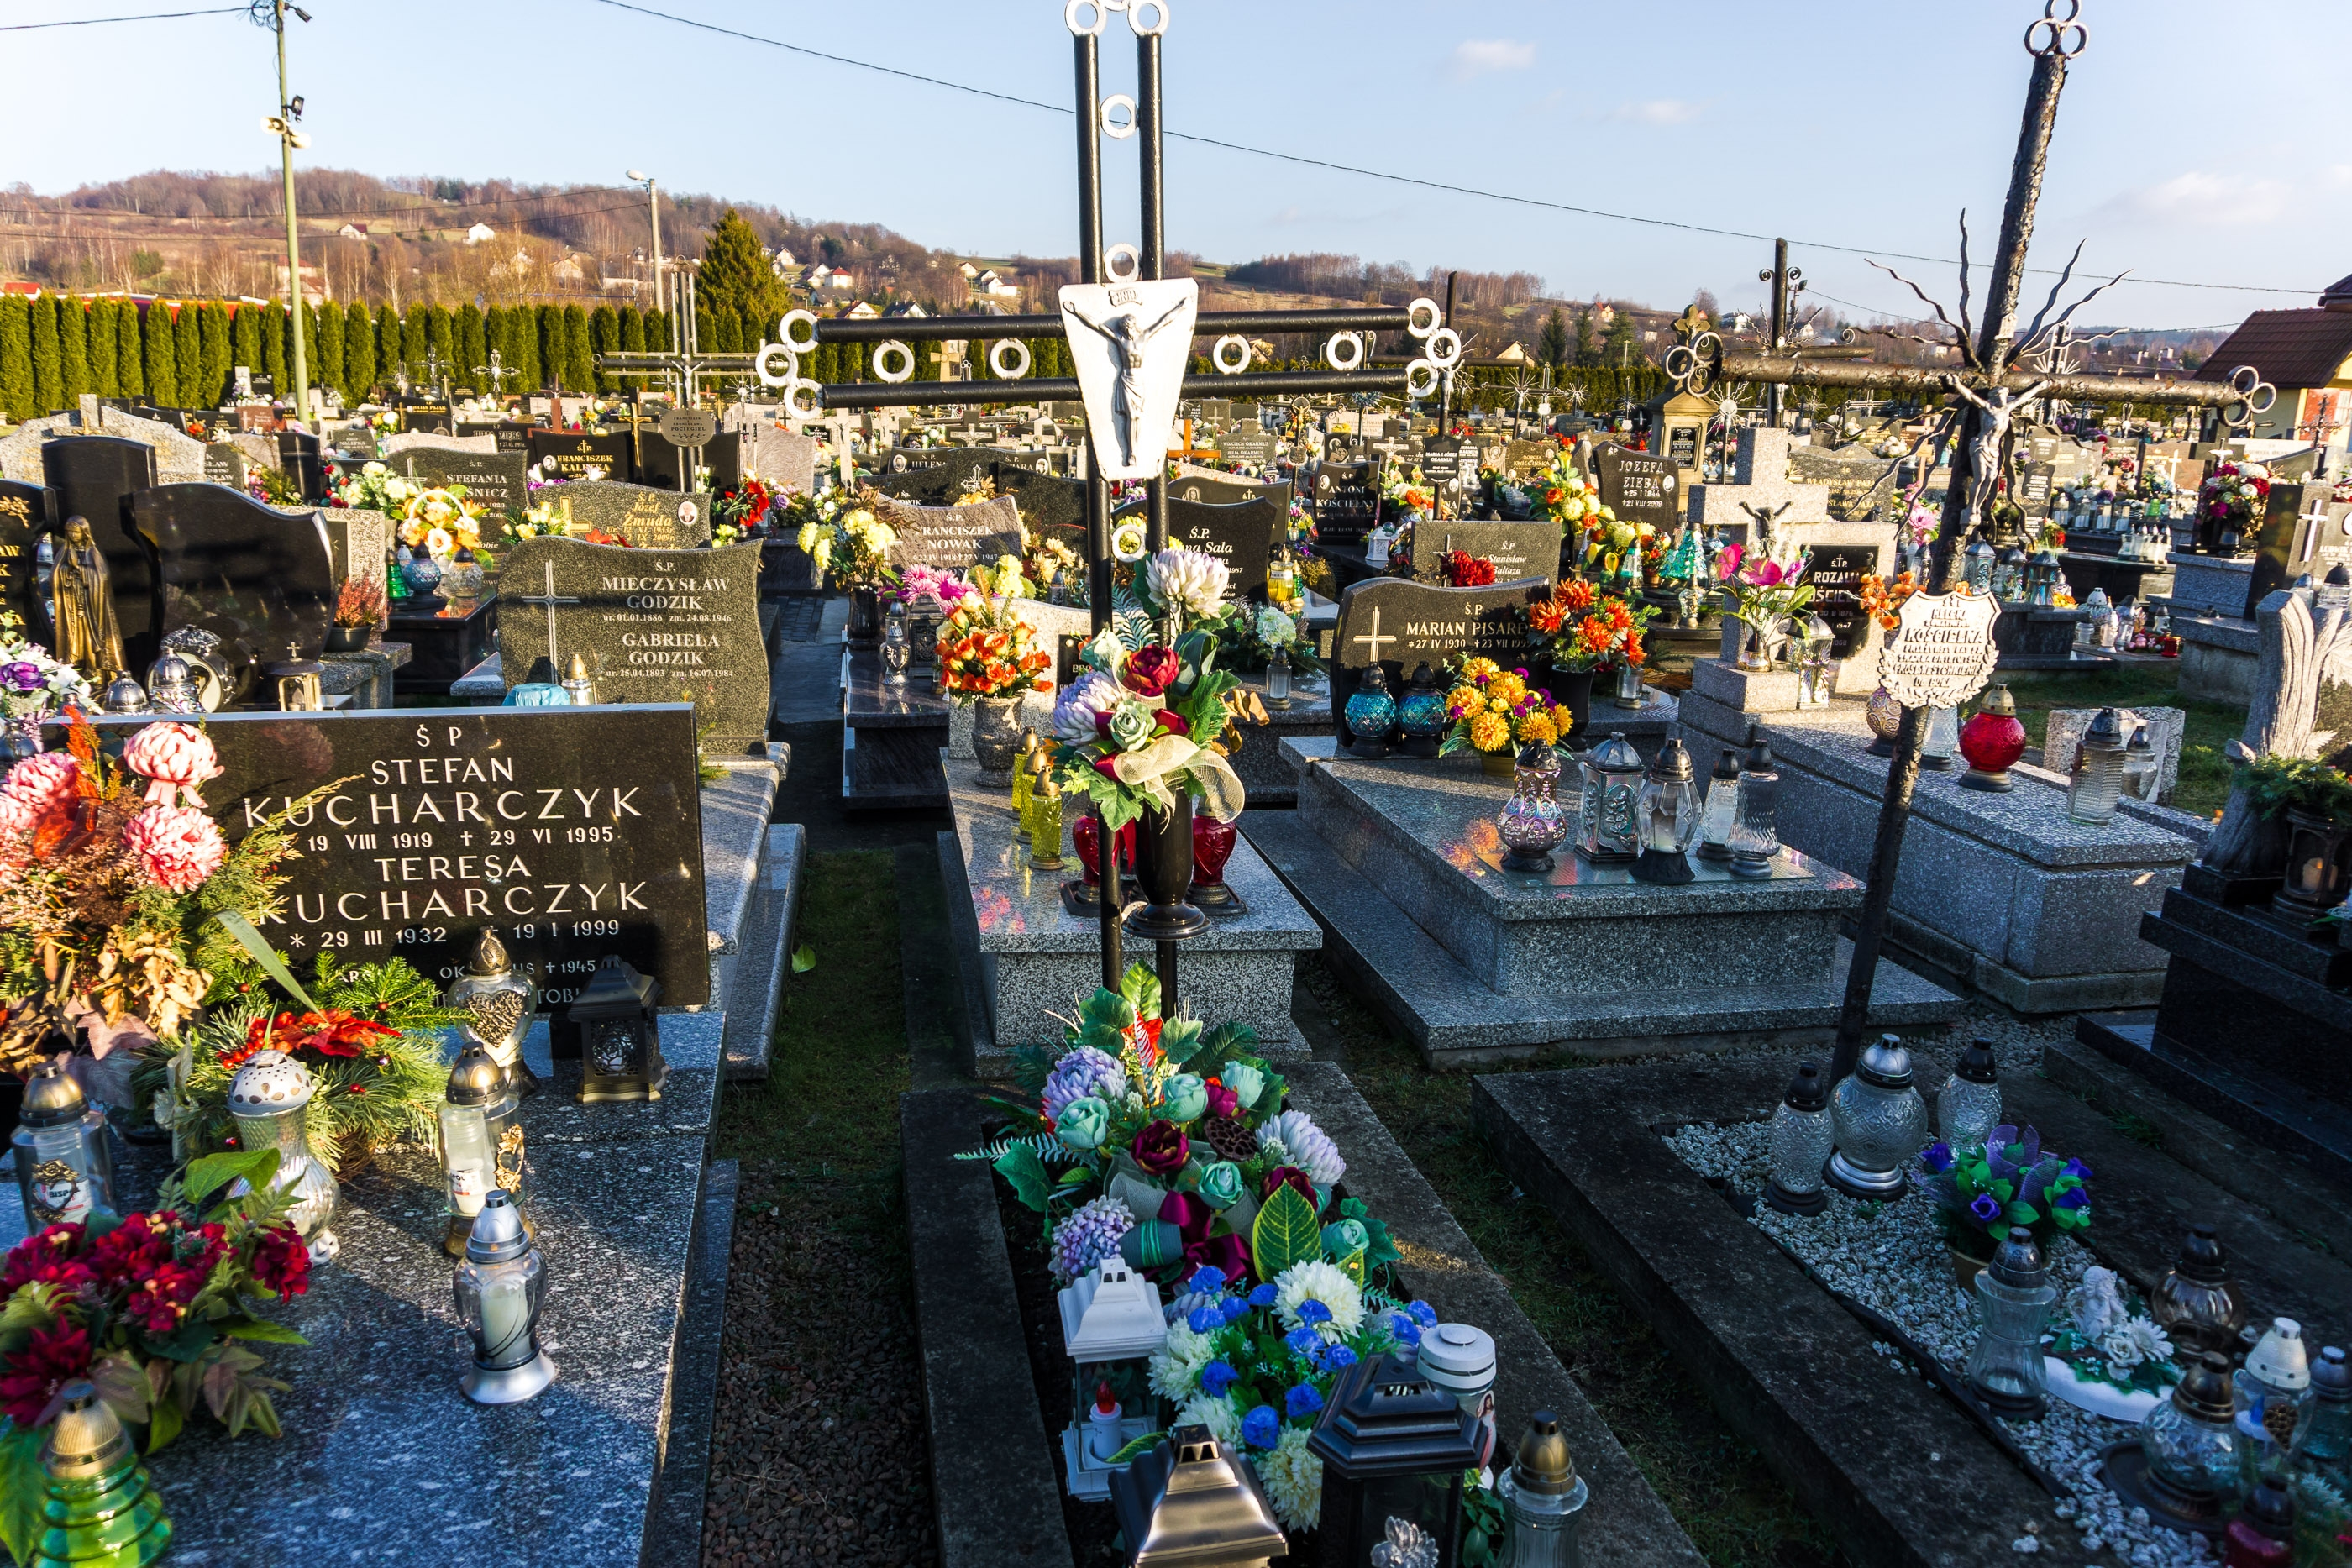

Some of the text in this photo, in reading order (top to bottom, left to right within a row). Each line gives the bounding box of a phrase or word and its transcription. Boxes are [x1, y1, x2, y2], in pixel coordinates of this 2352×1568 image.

[557, 454, 614, 463] FRANCISZEK
[1618, 459, 1664, 474] JÓZEFA
[446, 474, 507, 484] STEFANIA
[1623, 477, 1659, 490] ZIĘBA
[466, 487, 509, 498] ŚNICZ
[1328, 485, 1365, 494] ANTONI
[633, 502, 660, 513] Józef
[1316, 497, 1376, 509] KOŚCIELNY
[622, 513, 673, 527] Żmuda
[917, 526, 995, 536] RANCISZEK
[927, 539, 983, 549] NOWAK
[1205, 542, 1233, 553] Sala
[602, 577, 730, 591] MIECZYSŁAW
[1814, 571, 1861, 584] ROZALIA
[627, 595, 703, 610] GODZIK
[1407, 621, 1532, 636] MARIAN PISARE
[622, 632, 720, 647] GABRIELA
[1431, 640, 1441, 648] IV
[1444, 639, 1466, 648] 1930
[629, 651, 705, 664] GODZIK
[417, 724, 461, 747] Ś P
[371, 757, 513, 785] STEFAN
[244, 787, 642, 828] KUCHARCZYK
[308, 826, 613, 852] 19 VIII 1919 29 VI 1995
[374, 854, 532, 882] TERESA
[258, 882, 648, 925] KUCHARCZYK
[321, 931, 349, 947] 29
[365, 930, 382, 946] III
[396, 927, 447, 944] 1932
[513, 923, 535, 939] 19
[572, 920, 619, 936] 1999
[561, 960, 596, 973] 1945
